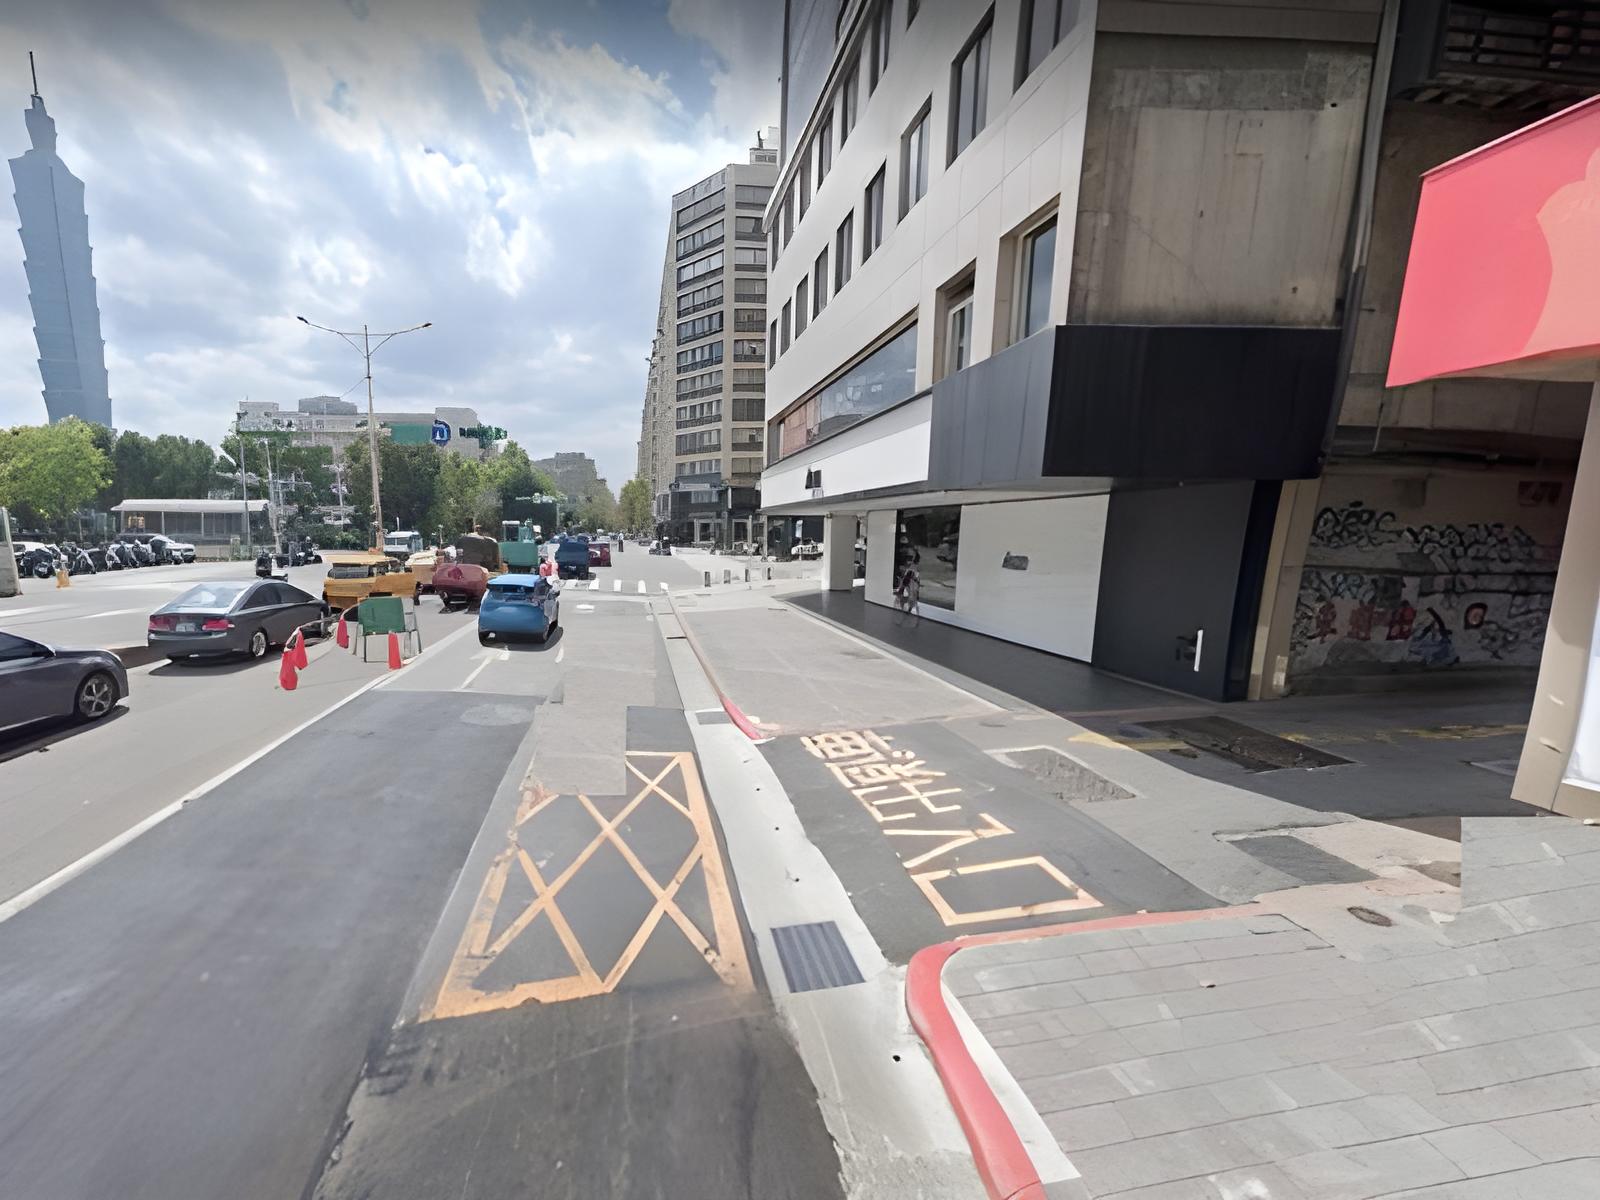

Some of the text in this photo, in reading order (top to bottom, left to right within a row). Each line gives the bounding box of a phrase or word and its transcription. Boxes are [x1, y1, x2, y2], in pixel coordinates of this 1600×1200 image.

[800, 729, 1104, 927] 車道出入口
